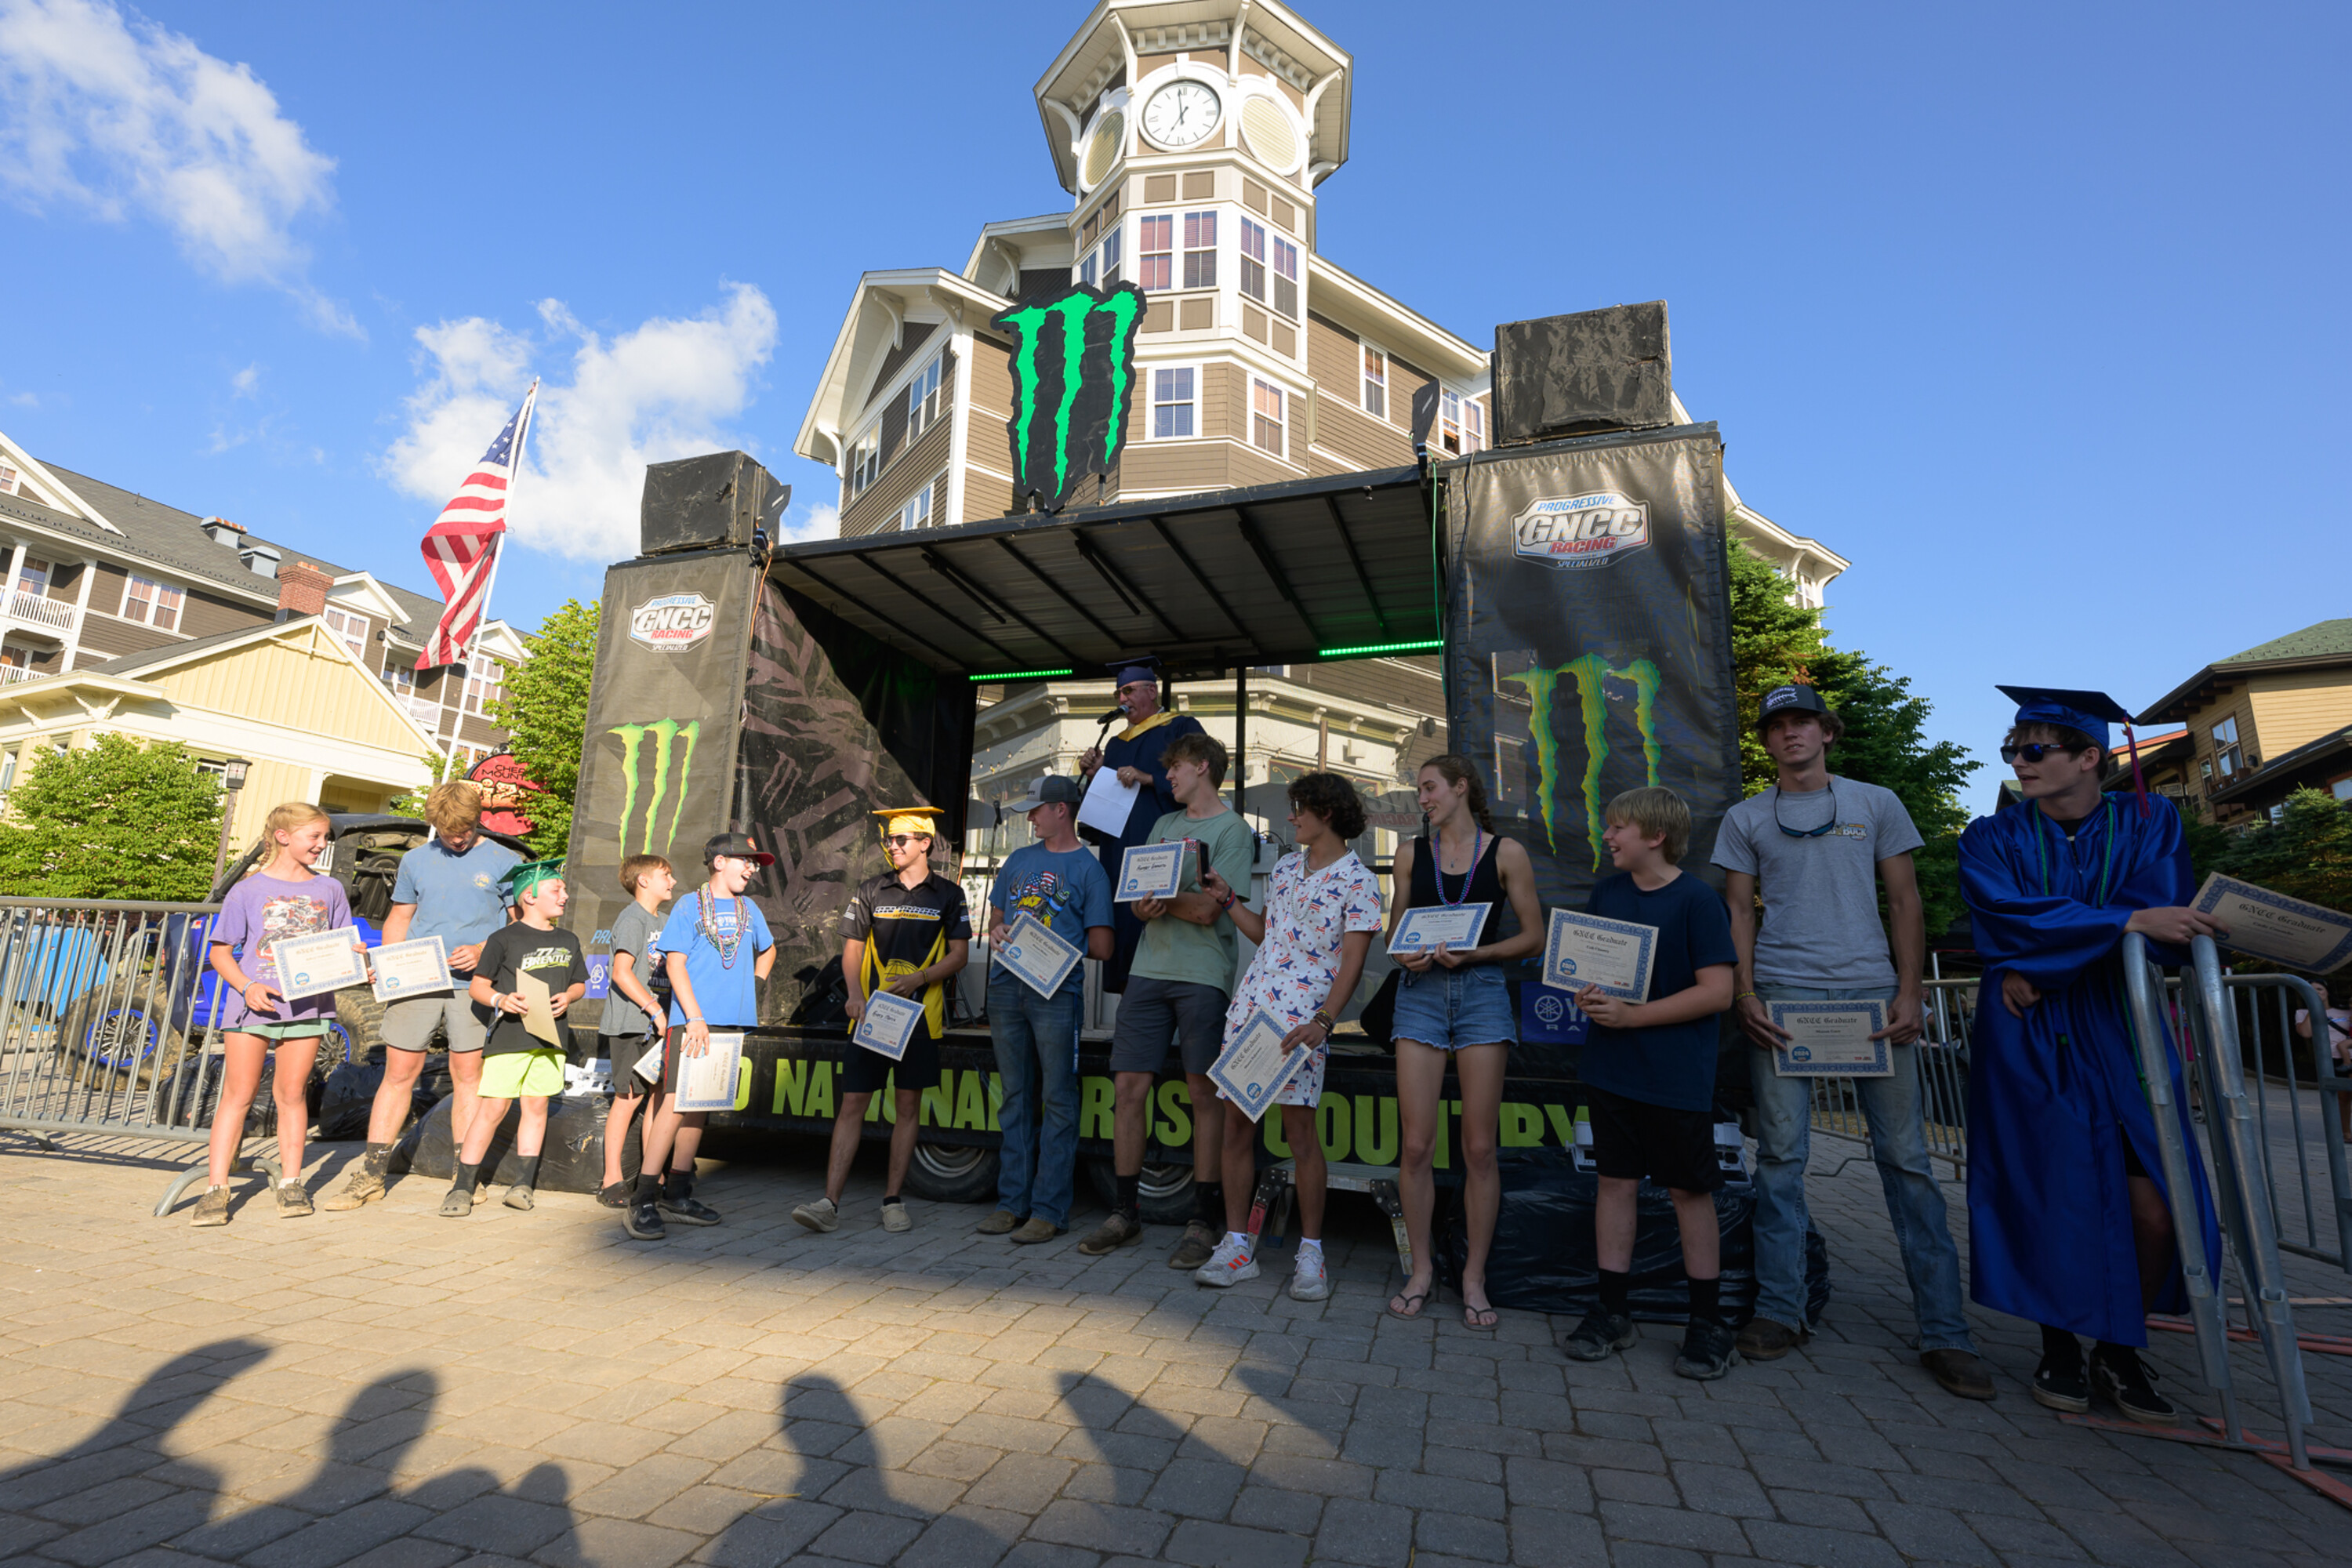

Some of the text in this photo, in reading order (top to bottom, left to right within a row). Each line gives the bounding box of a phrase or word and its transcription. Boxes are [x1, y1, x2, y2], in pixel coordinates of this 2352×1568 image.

[1537, 495, 1617, 512] PROGRESSIVE
[1519, 508, 1643, 546] GNCC
[1548, 536, 1617, 554] RACING
[1555, 557, 1610, 568] SPECIALIZED
[651, 596, 698, 608] PROGRESSIVE
[634, 604, 712, 633] GNCC
[651, 629, 694, 639] RACING
[481, 769, 526, 780] MOUNT
[2239, 902, 2277, 918] GNCC
[2278, 915, 2327, 934] Graduate
[1596, 934, 1628, 946] Graduate
[772, 1058, 1005, 1131] NANAL
[1263, 1091, 1590, 1169] COURY
